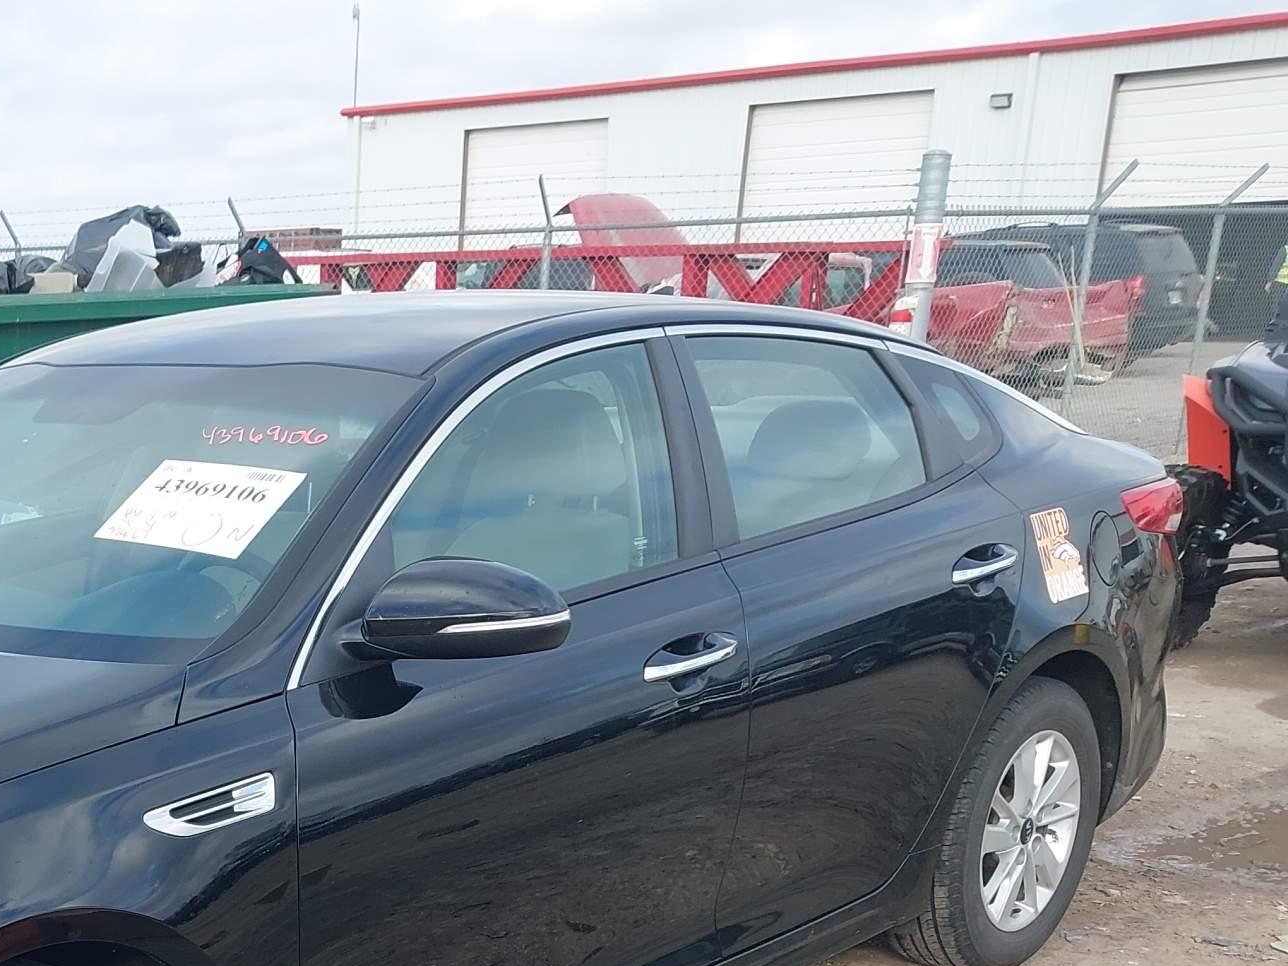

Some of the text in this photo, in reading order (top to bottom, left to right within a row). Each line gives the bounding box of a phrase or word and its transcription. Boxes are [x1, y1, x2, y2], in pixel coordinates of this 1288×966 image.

[202, 425, 329, 445] 43969106
[155, 478, 270, 504] 43969106
[1032, 510, 1069, 541] UNITED
[1039, 544, 1054, 572] IN
